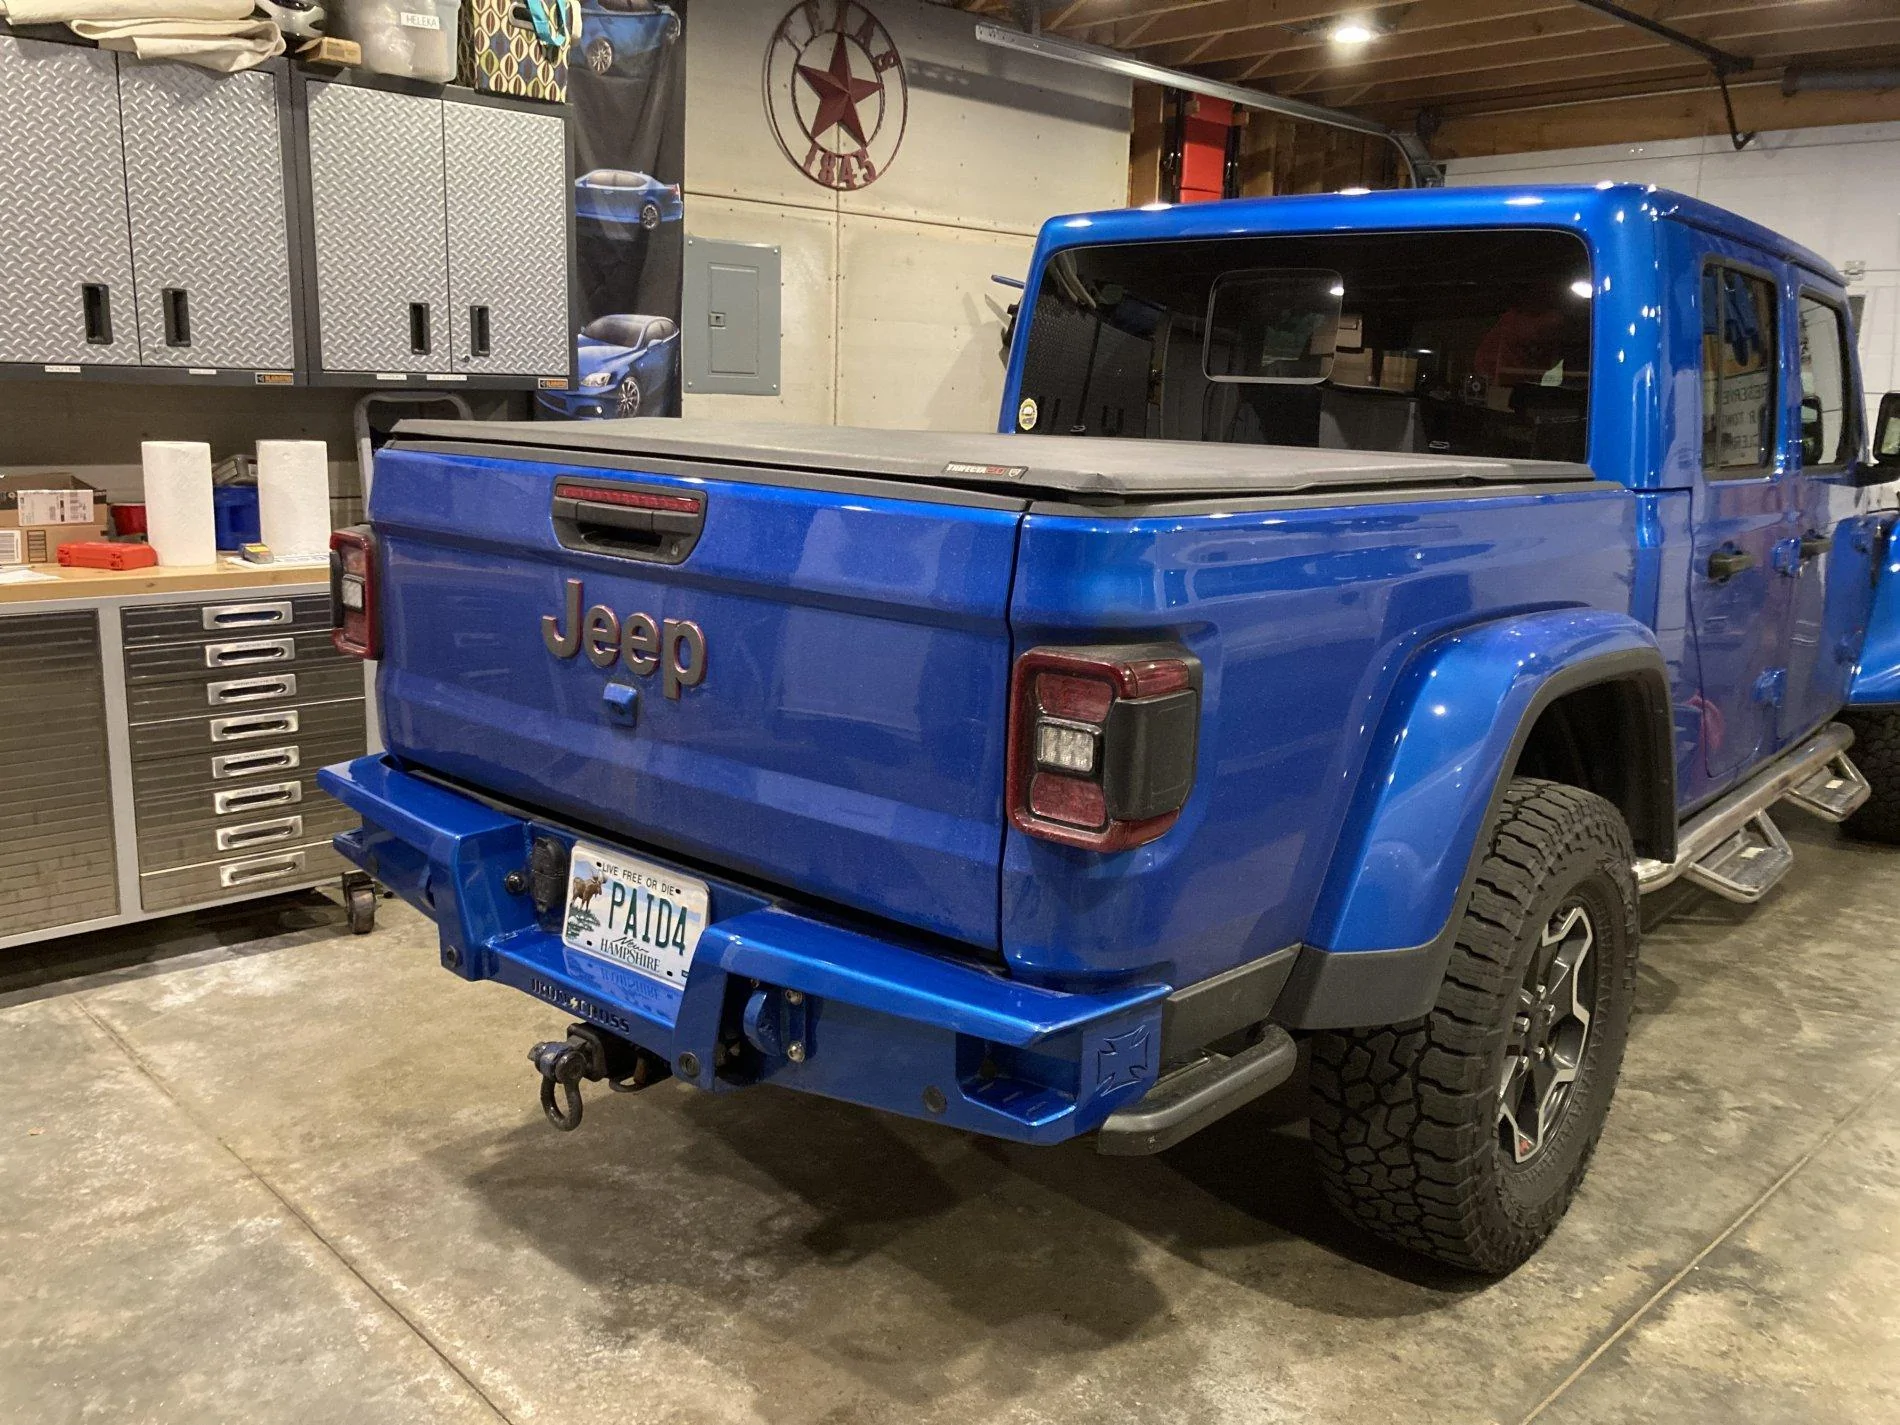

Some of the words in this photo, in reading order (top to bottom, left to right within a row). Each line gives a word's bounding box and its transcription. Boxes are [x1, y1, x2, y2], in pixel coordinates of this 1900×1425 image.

[803, 142, 877, 189] 1845
[542, 578, 707, 700] Jeep
[602, 863, 618, 876] LIVE
[622, 869, 642, 885] FREE
[646, 877, 658, 889] OR
[661, 883, 674, 896] DIE
[608, 881, 688, 956] PAID4
[600, 938, 661, 972] HAMPSHIRE
[612, 936, 649, 954] New
